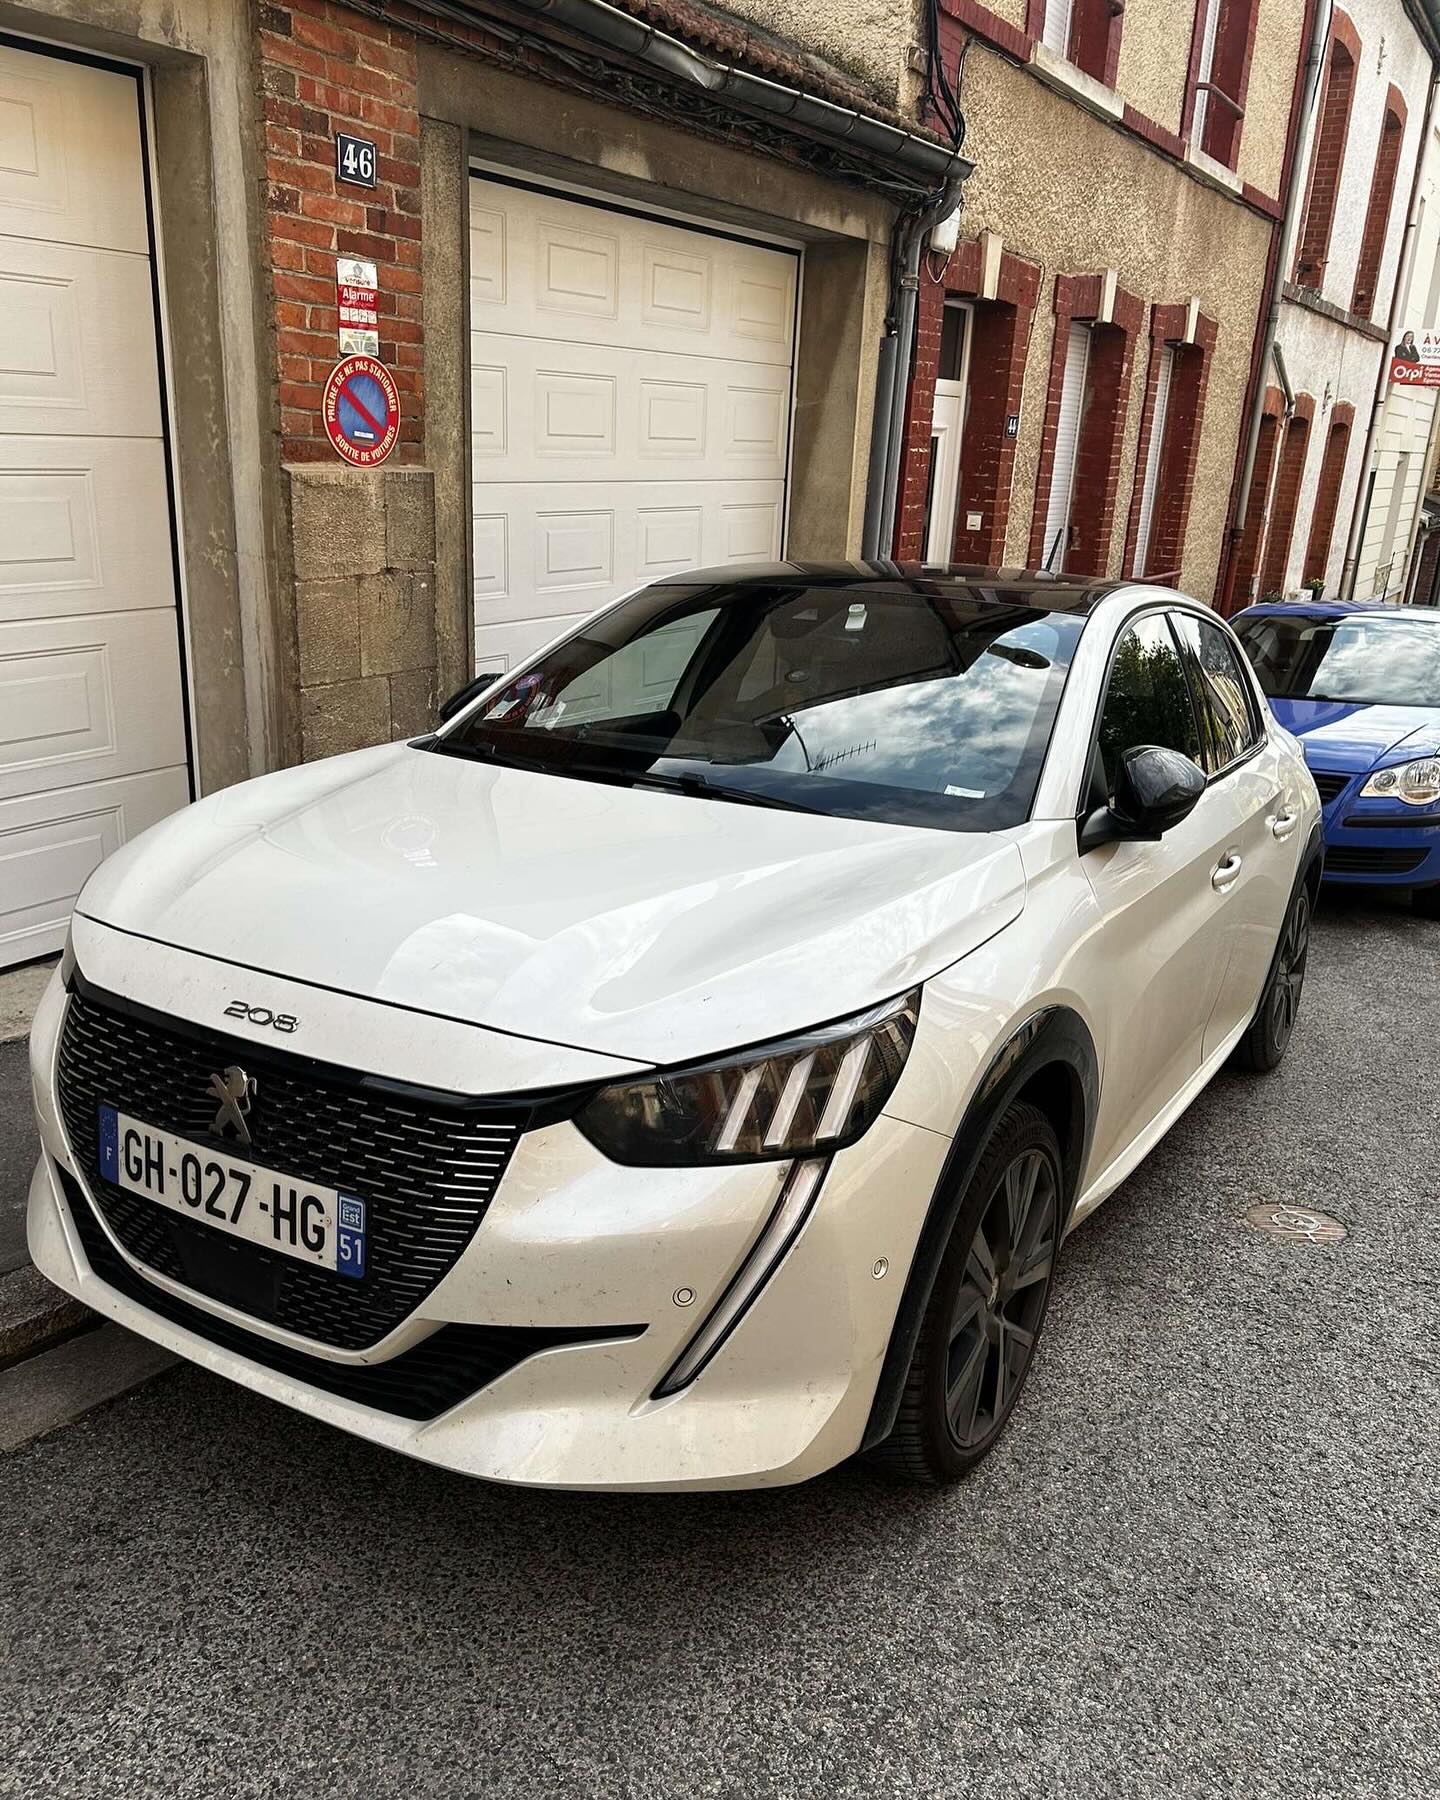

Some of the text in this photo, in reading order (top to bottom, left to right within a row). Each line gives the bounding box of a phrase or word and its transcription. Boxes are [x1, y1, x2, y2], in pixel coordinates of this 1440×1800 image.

[342, 143, 372, 179] 46
[342, 287, 374, 302] Alarme
[1423, 332, 1431, 345] À
[1393, 365, 1424, 381] Orpi
[327, 360, 397, 422] PRIÈRE DE NE PAS STATIONNER
[335, 425, 396, 462] SORTIE DE VOITURES
[223, 1000, 298, 1033] 208
[106, 1146, 113, 1161] F
[342, 1203, 360, 1214] Grand
[342, 1209, 360, 1224] Est
[340, 1233, 362, 1265] 51
